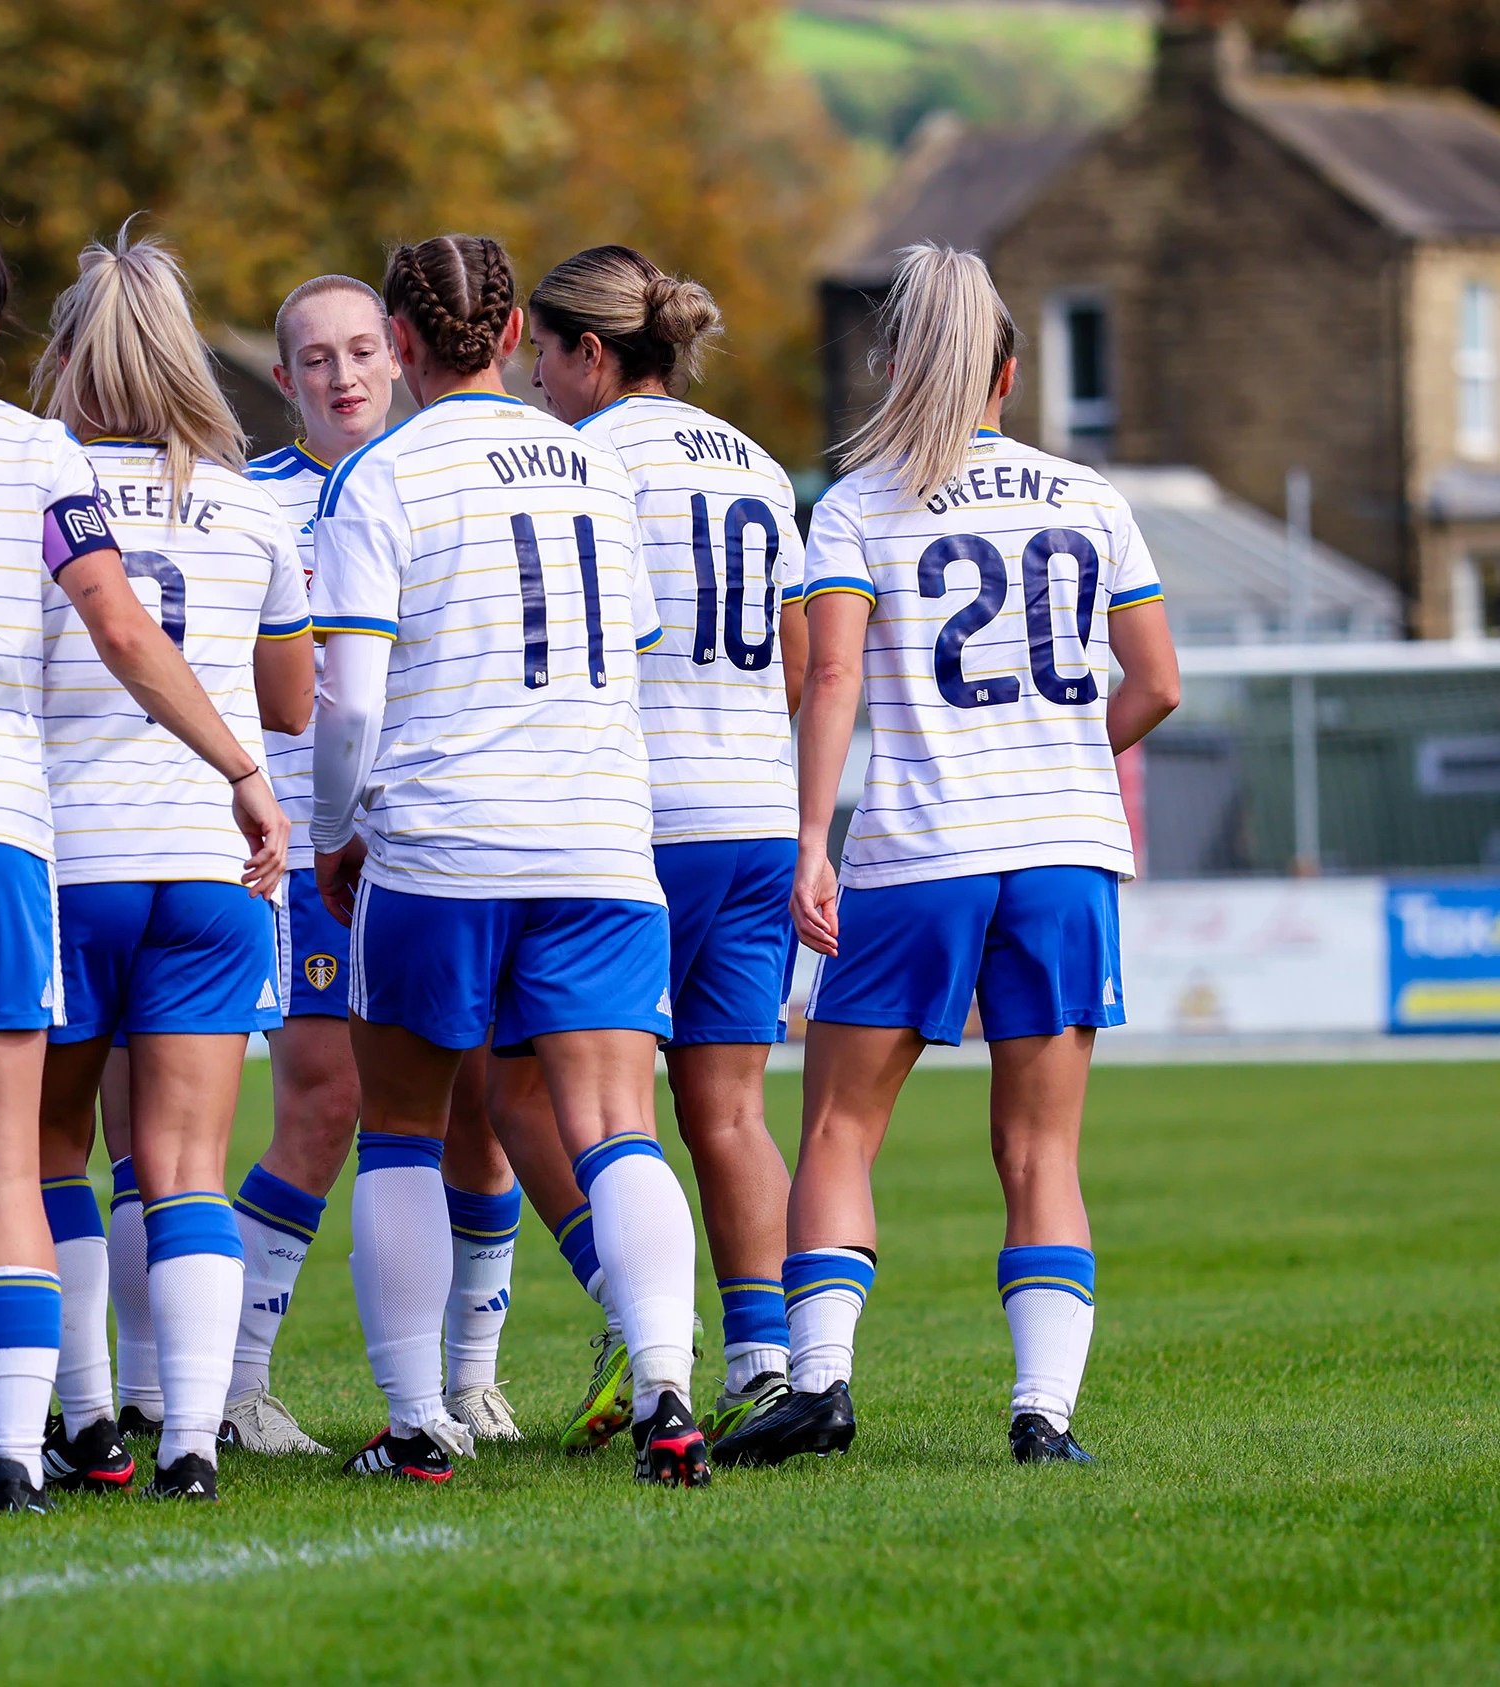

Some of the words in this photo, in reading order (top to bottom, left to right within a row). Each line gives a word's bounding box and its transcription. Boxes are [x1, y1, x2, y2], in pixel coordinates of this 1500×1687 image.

[486, 443, 588, 487] DIXON
[673, 428, 751, 470] SMITH
[99, 485, 222, 535] REENE
[918, 466, 1069, 515] GREENE
[510, 512, 607, 690] 11
[690, 492, 779, 672] 10
[917, 527, 1099, 709] 20
